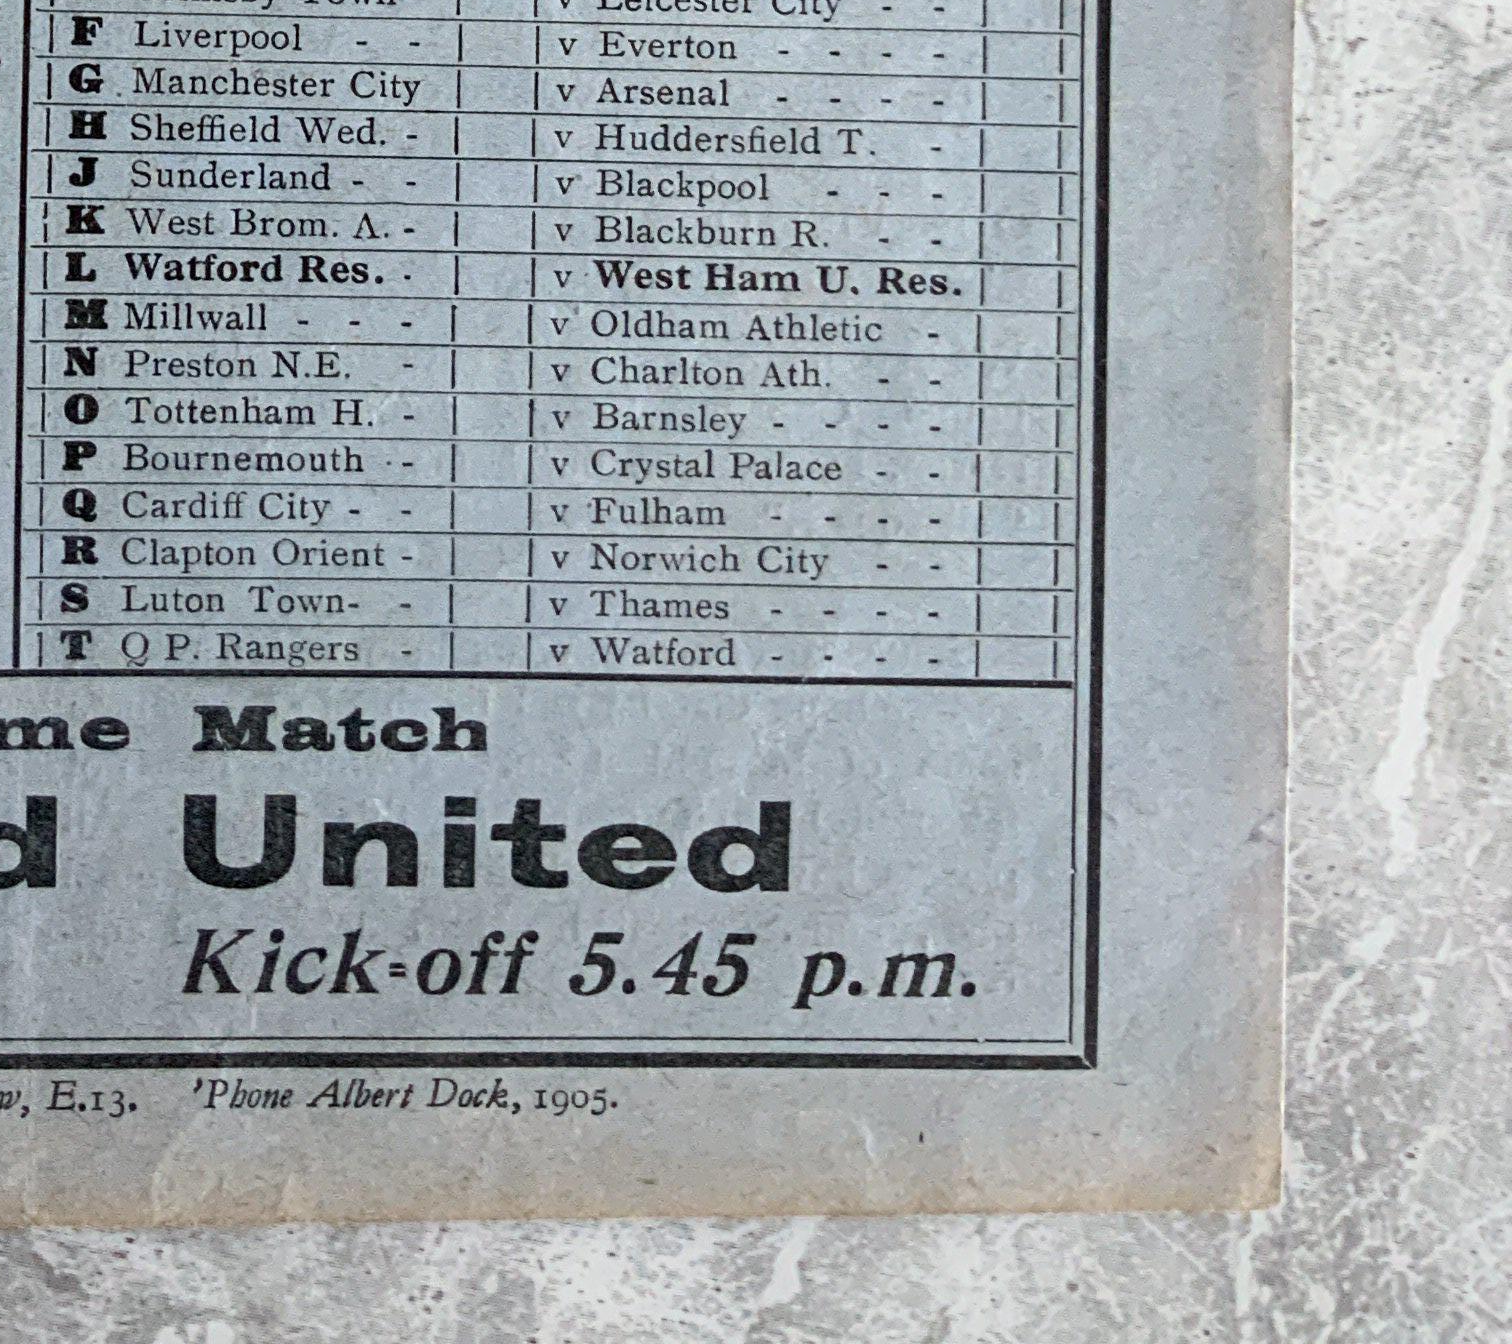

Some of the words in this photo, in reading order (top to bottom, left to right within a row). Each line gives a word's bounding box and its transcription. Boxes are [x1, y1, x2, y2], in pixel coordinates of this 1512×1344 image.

[64, 250, 97, 283] L
[123, 251, 284, 283] Watford
[297, 254, 384, 285] Res.
[592, 259, 692, 291] West
[704, 262, 802, 293] Ham
[815, 265, 860, 296] U.
[876, 266, 962, 297] Res.
[590, 636, 737, 667] Watford
[191, 704, 488, 753] Match
[182, 793, 792, 894] United
[181, 927, 540, 996] Kick-off
[568, 931, 758, 998] 5.45
[791, 951, 977, 1011] p.m.
[45, 1079, 138, 1119] E.13.
[305, 1078, 414, 1110] Albert
[426, 1077, 521, 1116] Dock,
[534, 1087, 618, 1117] 1905.
